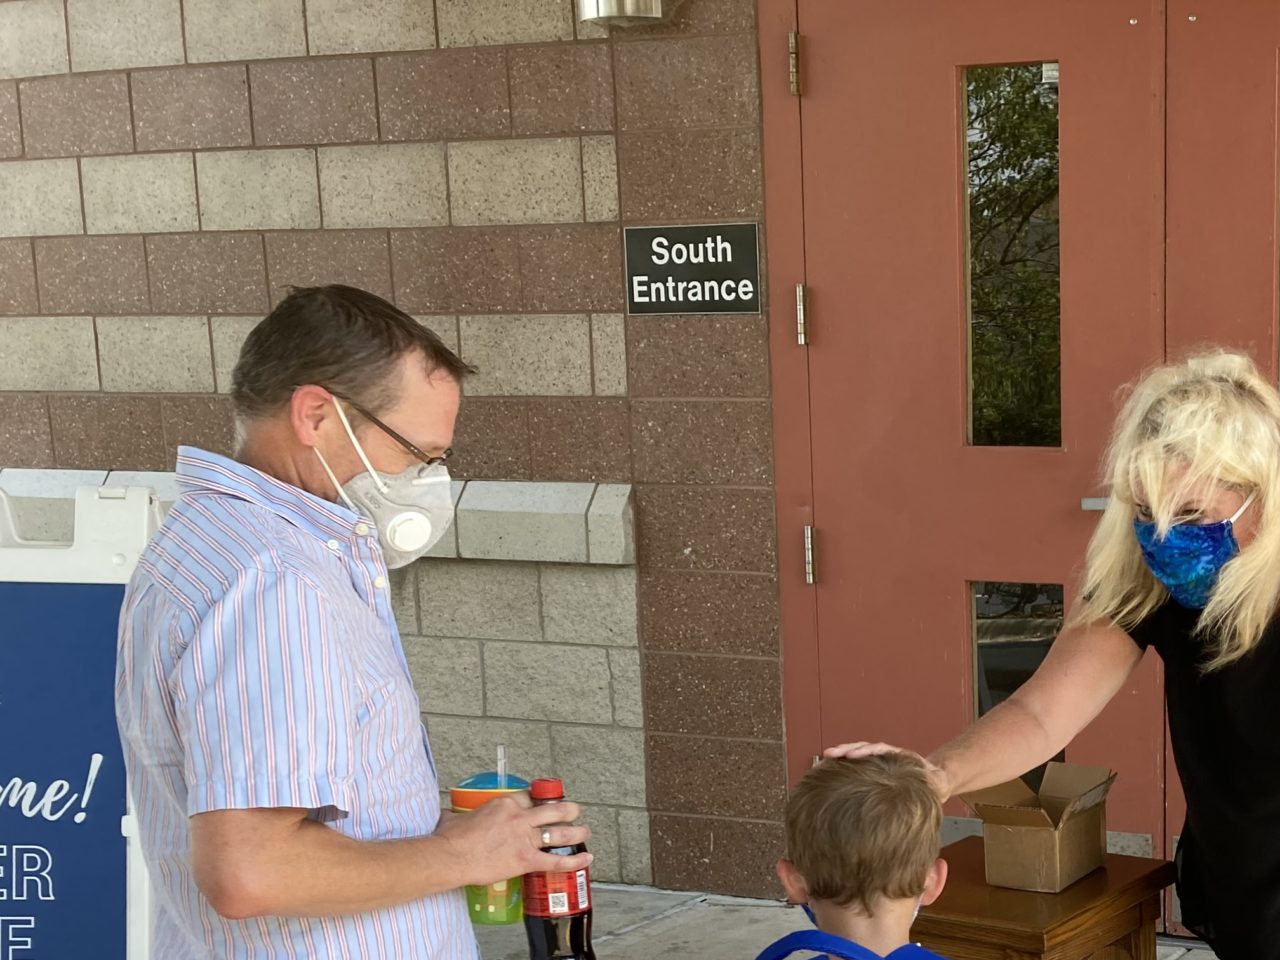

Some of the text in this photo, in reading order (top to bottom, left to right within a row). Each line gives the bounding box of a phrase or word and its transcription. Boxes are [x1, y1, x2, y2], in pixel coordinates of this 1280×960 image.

[651, 235, 732, 265] South
[632, 275, 754, 303] Entrance
[0, 753, 103, 823] me!
[0, 845, 55, 900] R
